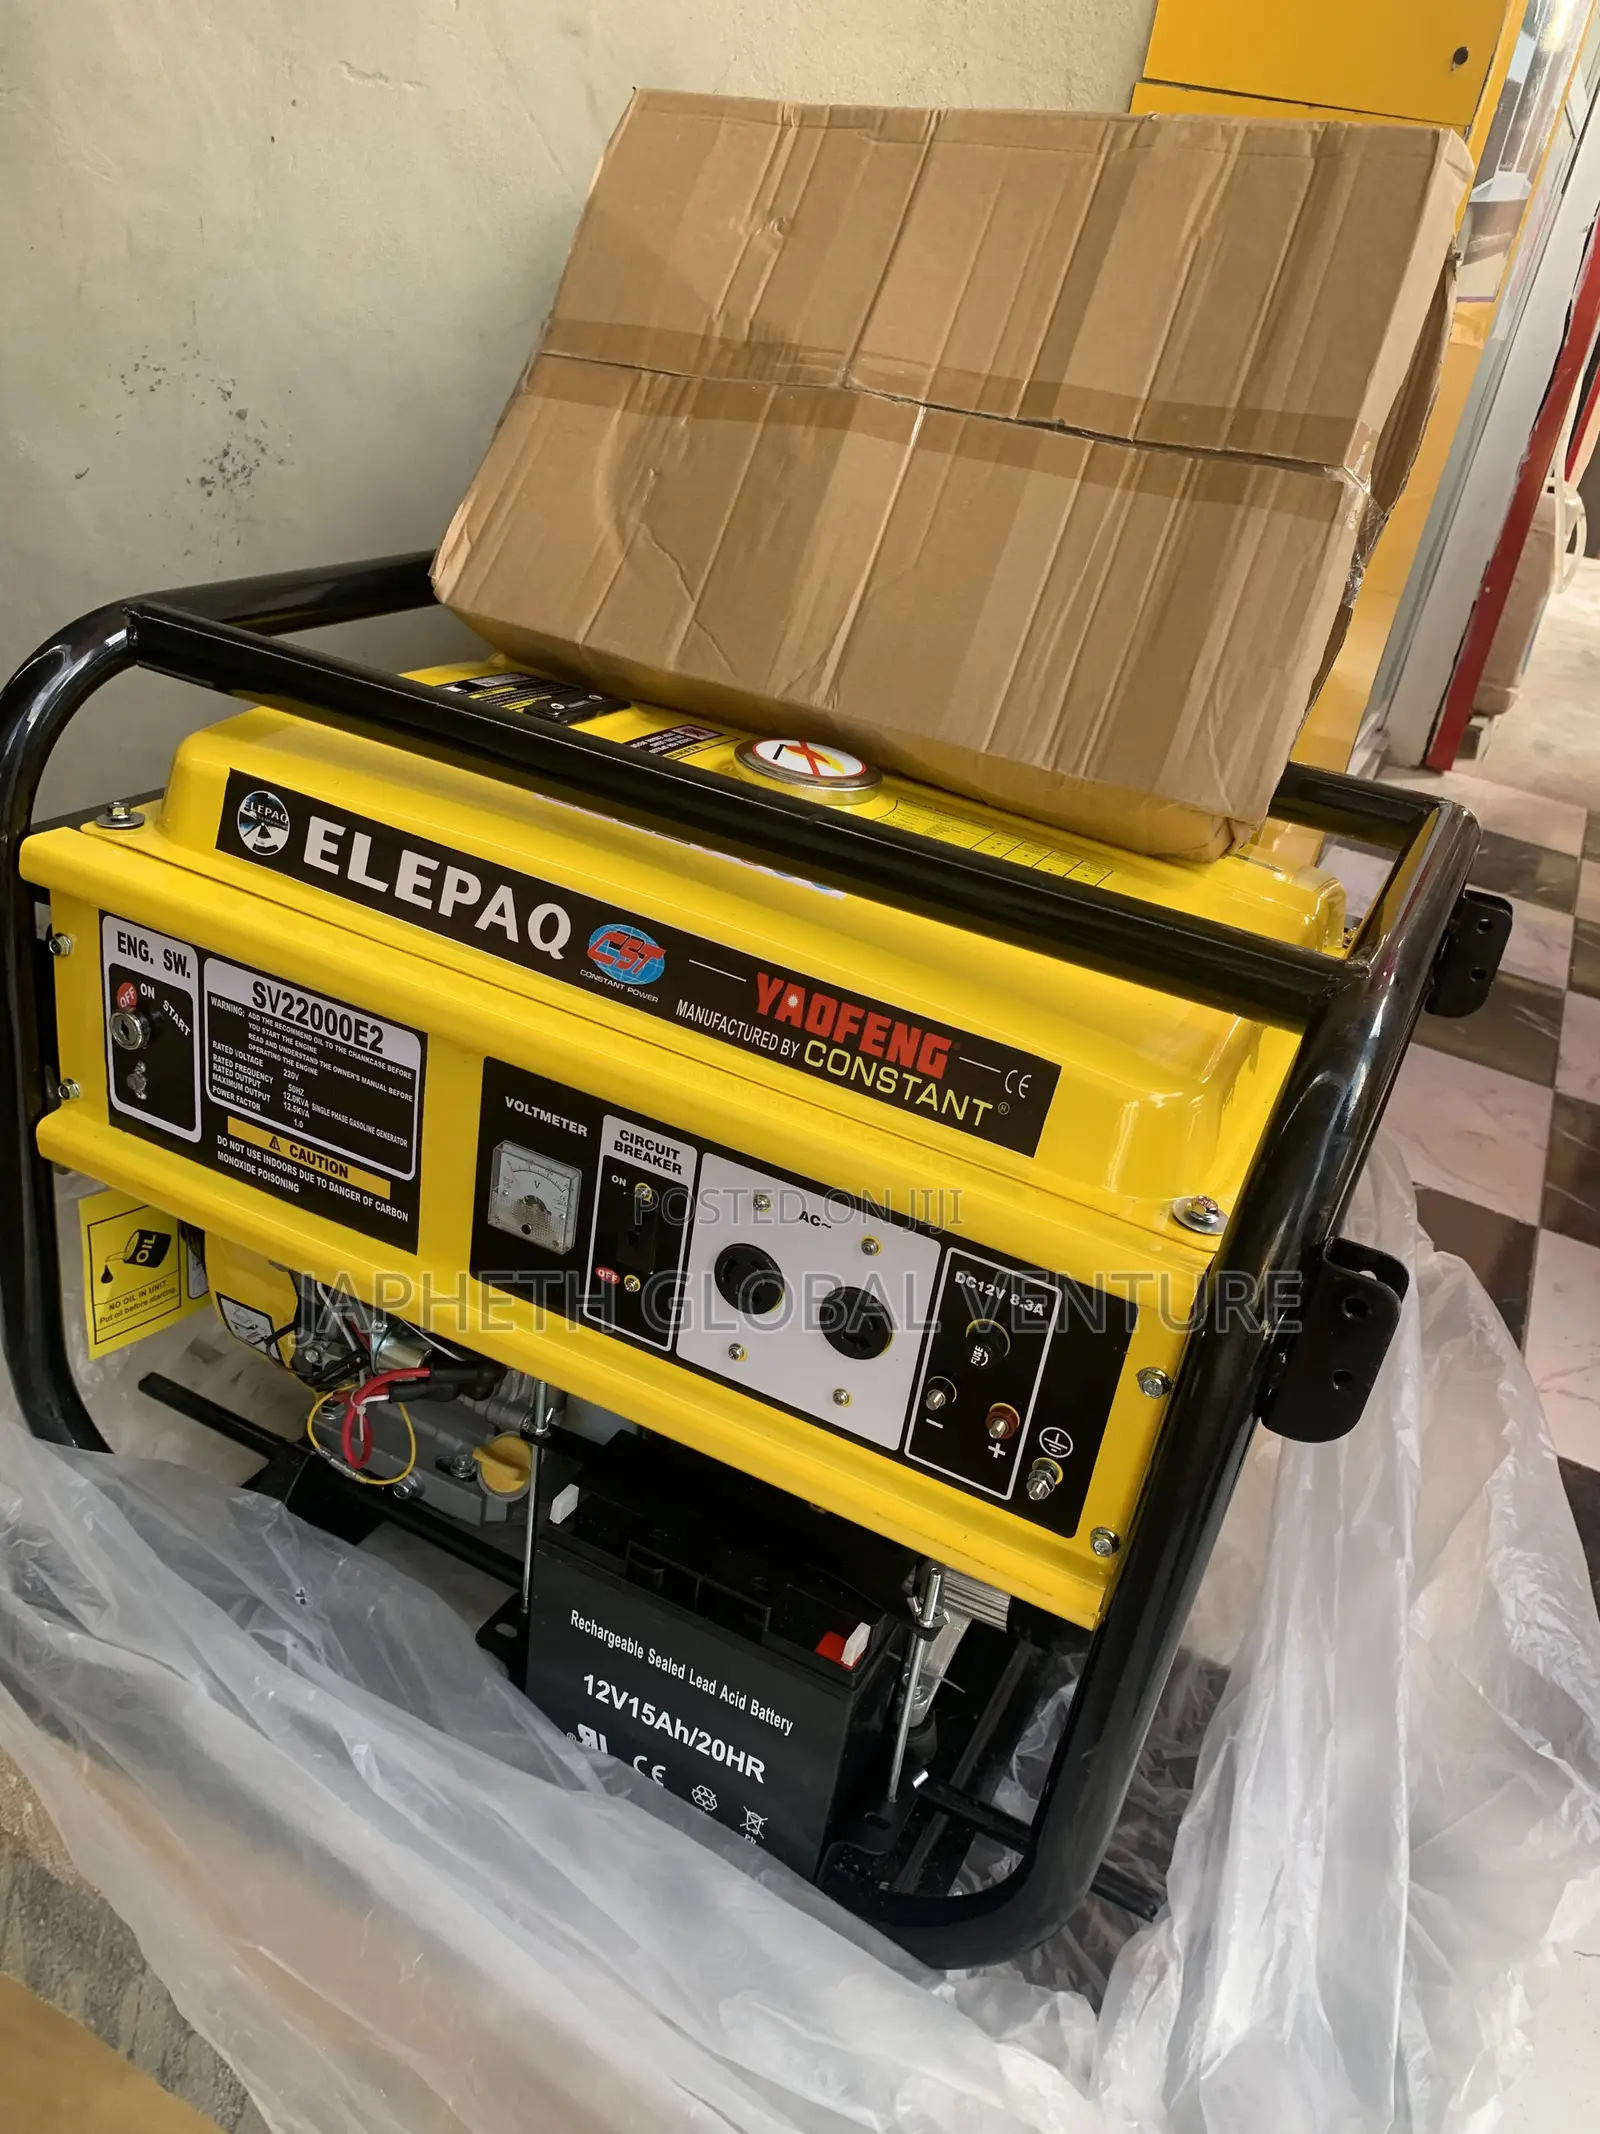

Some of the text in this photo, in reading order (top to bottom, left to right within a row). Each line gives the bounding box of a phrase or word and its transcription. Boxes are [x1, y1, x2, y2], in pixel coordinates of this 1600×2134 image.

[244, 800, 289, 825] ELEPAQ
[303, 815, 572, 960] ELEPAQ
[116, 930, 191, 979] ENG. SW.
[119, 985, 136, 1008] OFF
[140, 983, 155, 999] ON
[579, 969, 659, 1003] CONSTANT POWER
[162, 1000, 191, 1036] START
[252, 980, 384, 1055] SV22000E2
[756, 971, 952, 1079] YAOFENG
[210, 996, 245, 1017] WARNING:
[248, 1012, 260, 1021] ADD
[262, 1017, 273, 1026] THE
[275, 1022, 312, 1041] RECOMMEND
[313, 1037, 324, 1046] OIL
[325, 1041, 333, 1050] TO
[335, 1045, 347, 1055] THE
[387, 1063, 412, 1080] BEFORE
[248, 1022, 318, 1054] YOU START THE ENGINE
[212, 1040, 299, 1081] RATED VOLTAGE 220V
[212, 1053, 305, 1096] RATED FREQUENCY 50HZ
[212, 1063, 233, 1077] RATED
[235, 1072, 261, 1088] OUTPUT
[248, 1043, 319, 1076] OPERATING THE ENGINE
[248, 1033, 413, 1103] READ AND UNDERSTAND THE OWNER'S MANUAL BEFORE
[675, 999, 993, 1126] MANUFACTURED BY CONSTANT
[212, 1073, 243, 1091] MAXIMUM
[244, 1086, 271, 1103] OUTPUT
[1004, 1069, 1032, 1099] CE
[212, 1085, 304, 1128] POWER FACTOR 1.0
[504, 1095, 588, 1138] VOLTMETER
[312, 1103, 408, 1148] SINGLE PHASE GASOLINE GENERATOR
[289, 1144, 349, 1179] CAUTION
[614, 1140, 682, 1176] BREAKER
[619, 1129, 680, 1161] CIRCUIT
[217, 1151, 300, 1193] MONOXIDE POISONING
[217, 1135, 409, 1223] DO NOT USE INDOORS DUE TO DANGER OF CARBON
[611, 1174, 627, 1187] ON
[136, 1234, 156, 1264] OIL
[597, 1269, 619, 1283] OFF
[954, 1271, 1044, 1316] DC12V 8.3A
[100, 1314, 113, 1324] Put
[114, 1309, 123, 1318] oil
[124, 1299, 149, 1314] before
[109, 1301, 121, 1311] NO
[123, 1295, 136, 1305] OIL
[138, 1289, 147, 1298] IN
[970, 1344, 984, 1366] FUSE
[570, 1609, 794, 1736] Rechargeable Sealed Lead Acid Battery
[583, 1674, 766, 1784] 12V15Ah/20HR
[633, 1755, 667, 1787] CE
